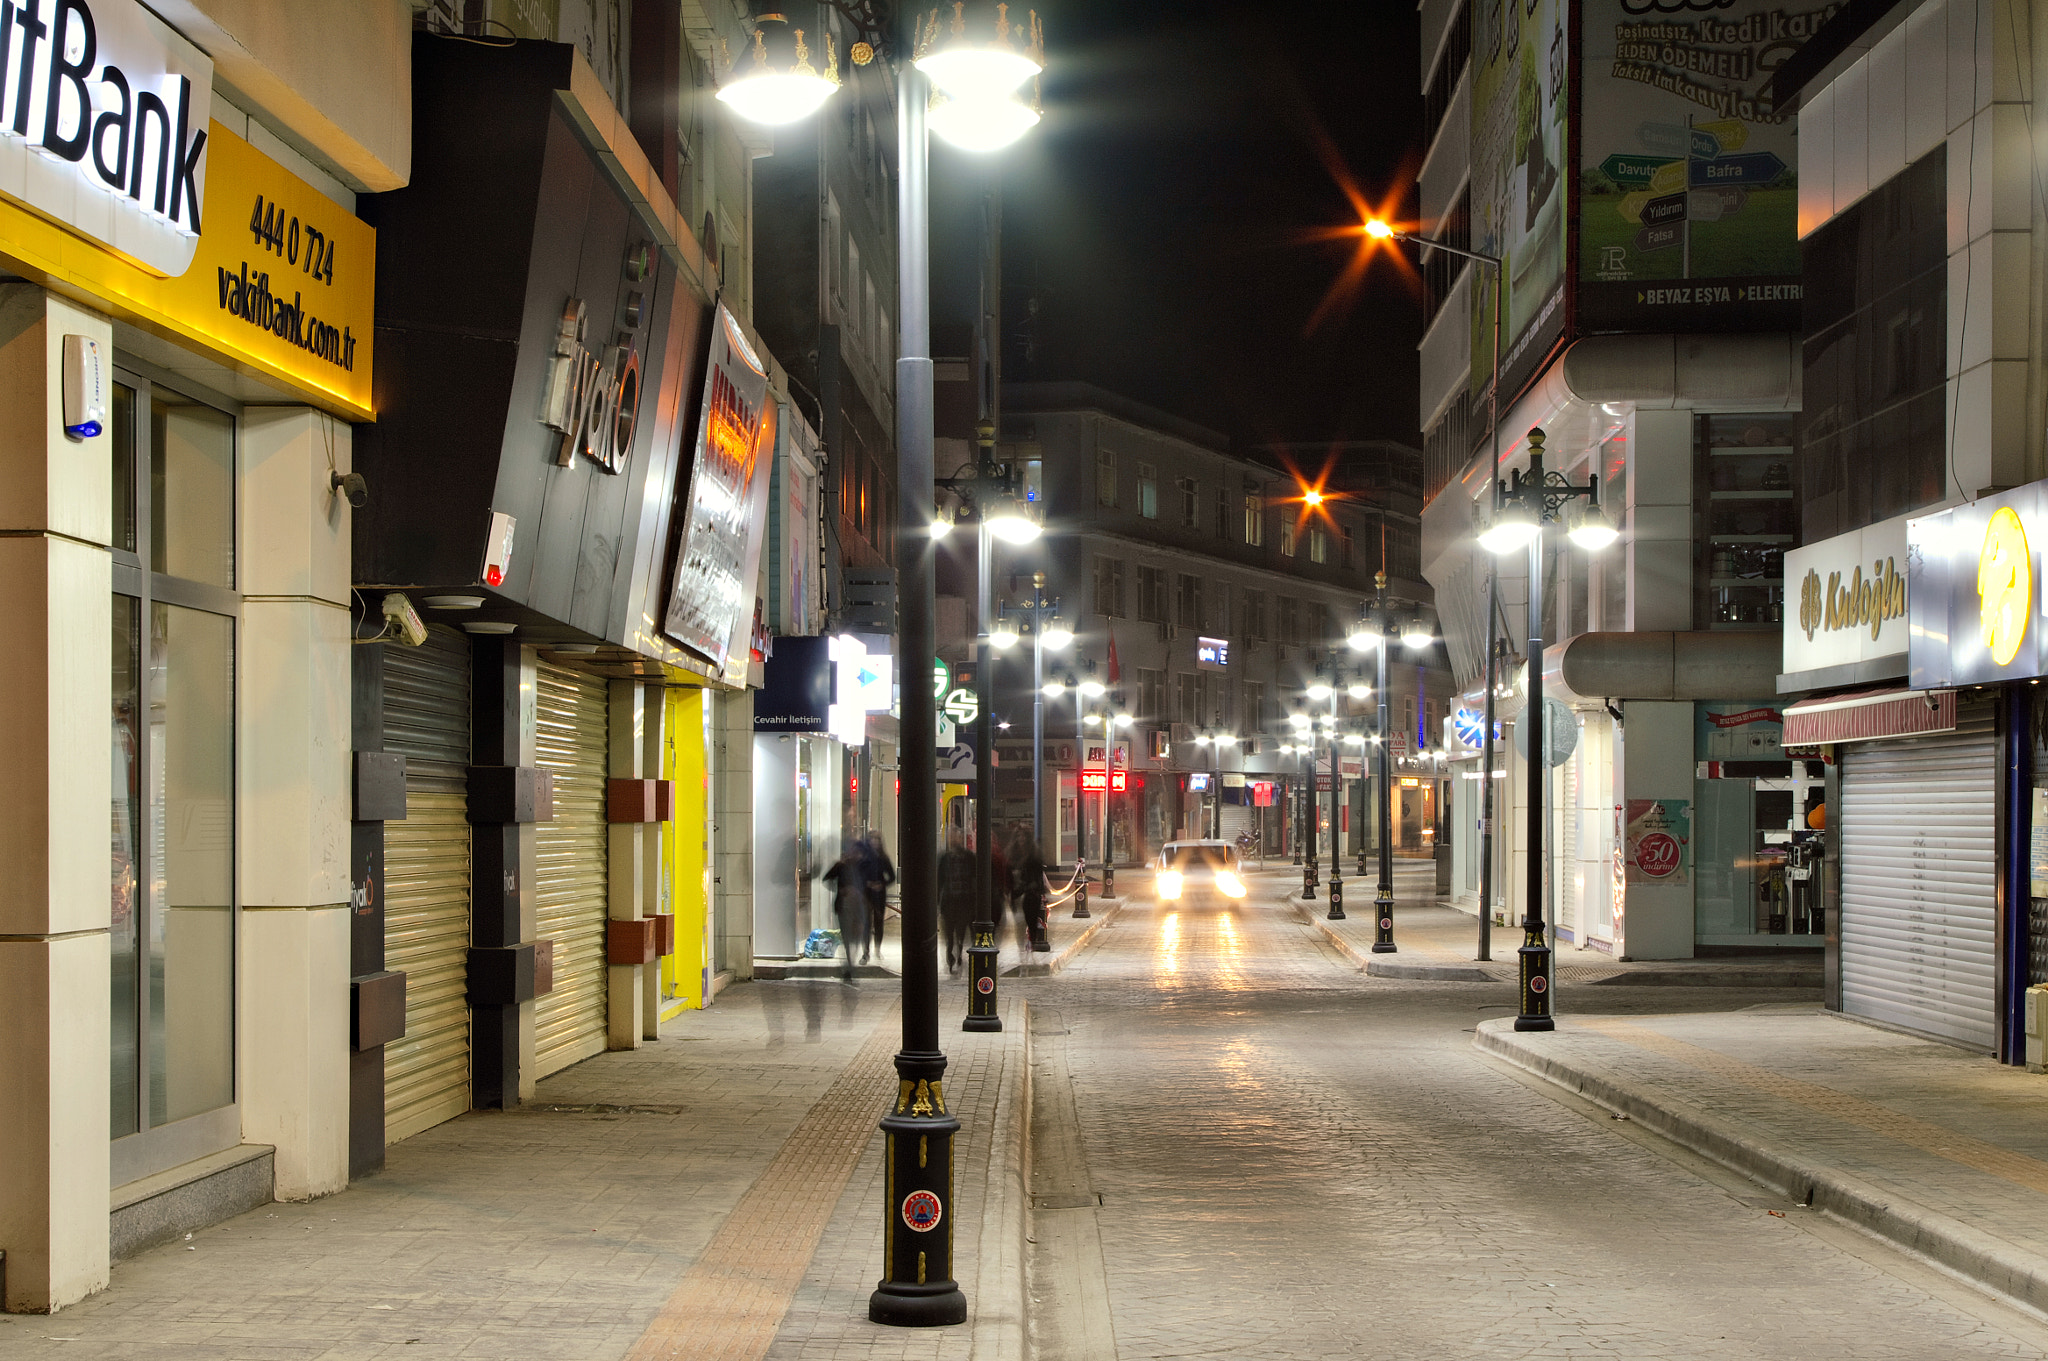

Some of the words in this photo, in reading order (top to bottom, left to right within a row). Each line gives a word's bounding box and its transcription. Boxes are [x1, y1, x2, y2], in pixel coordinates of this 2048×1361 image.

[1615, 23, 1696, 46] Peşinatsız,
[1700, 15, 1762, 43] Kredi
[1615, 42, 1658, 62] ELDEN
[1661, 42, 1750, 80] ÖDEMELİ
[1612, 62, 1651, 87] Taksit
[1691, 137, 1713, 152] Ordu
[1707, 164, 1743, 178] Bafra
[1649, 202, 1683, 219] Yıldırım
[250, 194, 285, 257] 444
[288, 216, 300, 265] 0
[303, 224, 335, 286] 724
[1647, 229, 1673, 243] Fatsa
[1647, 288, 1690, 305] BEYAZ
[1694, 286, 1731, 306] EŞYA
[754, 715, 788, 724] Cevahir
[789, 714, 822, 725] İletişim
[1645, 841, 1674, 862] 50
[1643, 861, 1674, 870] indirim
